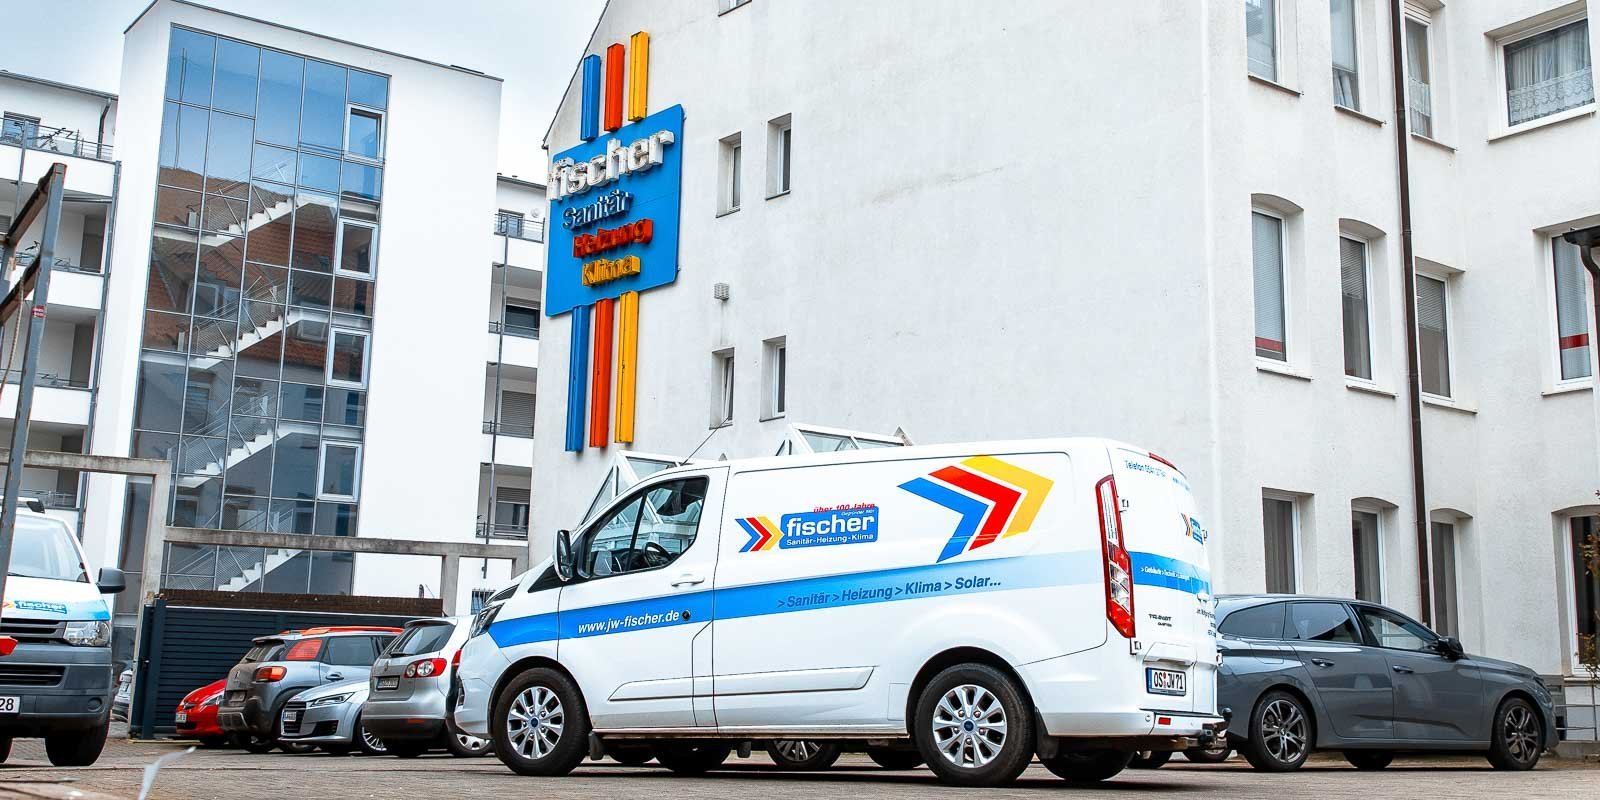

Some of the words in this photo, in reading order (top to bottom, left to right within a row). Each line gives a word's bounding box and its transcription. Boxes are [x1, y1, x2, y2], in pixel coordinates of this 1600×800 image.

[548, 130, 675, 201] fischer
[563, 189, 634, 229] Sanitär
[573, 218, 654, 258] Heizung
[582, 255, 641, 287] Klima
[852, 502, 875, 510] Jahre
[786, 514, 875, 537] fischer
[578, 609, 680, 634] www.jw-fischer.de
